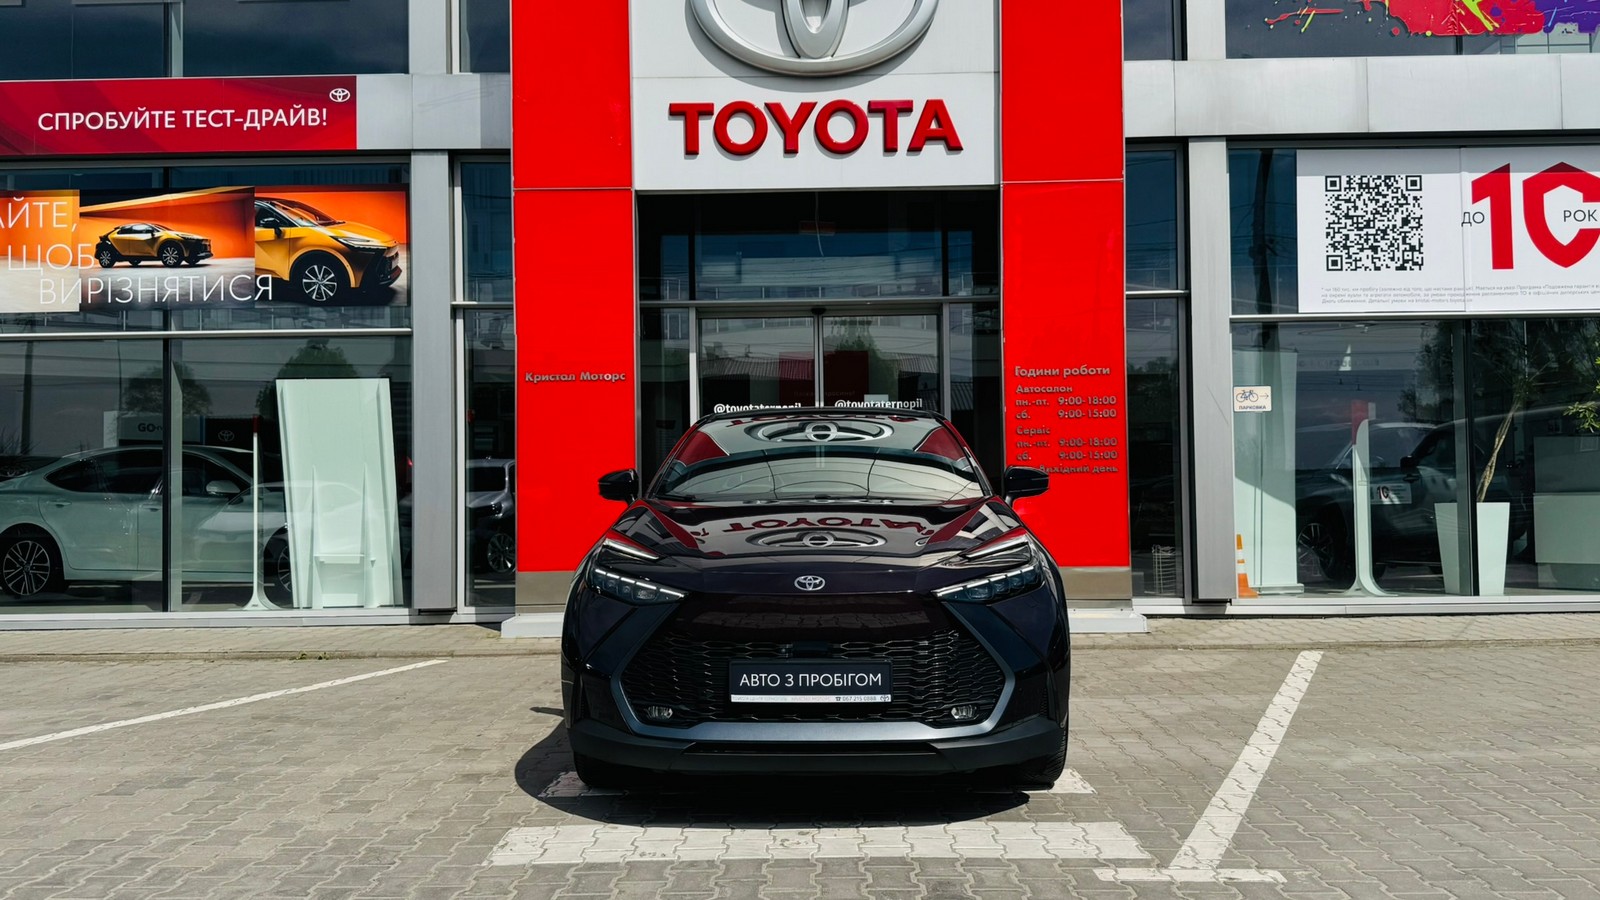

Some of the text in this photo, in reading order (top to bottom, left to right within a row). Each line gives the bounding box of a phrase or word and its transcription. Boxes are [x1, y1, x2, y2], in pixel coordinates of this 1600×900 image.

[37, 104, 327, 131] СПРОБУЙТЕ ТЕСТ-ДРАЙВ!
[668, 98, 964, 156] TOYOTA
[1461, 212, 1485, 228] ДО
[8, 243, 95, 276] ЩОБ
[39, 274, 273, 305] ВИРІЗНЯТИСЯ
[525, 371, 626, 383] Кристал Моторс
[1015, 364, 1110, 378] Години роботи
[1015, 385, 1073, 394] Автосалон
[1016, 425, 1051, 437] Сервіс
[739, 673, 781, 687] АВТО
[798, 673, 882, 687] ПРОБІГОМ
